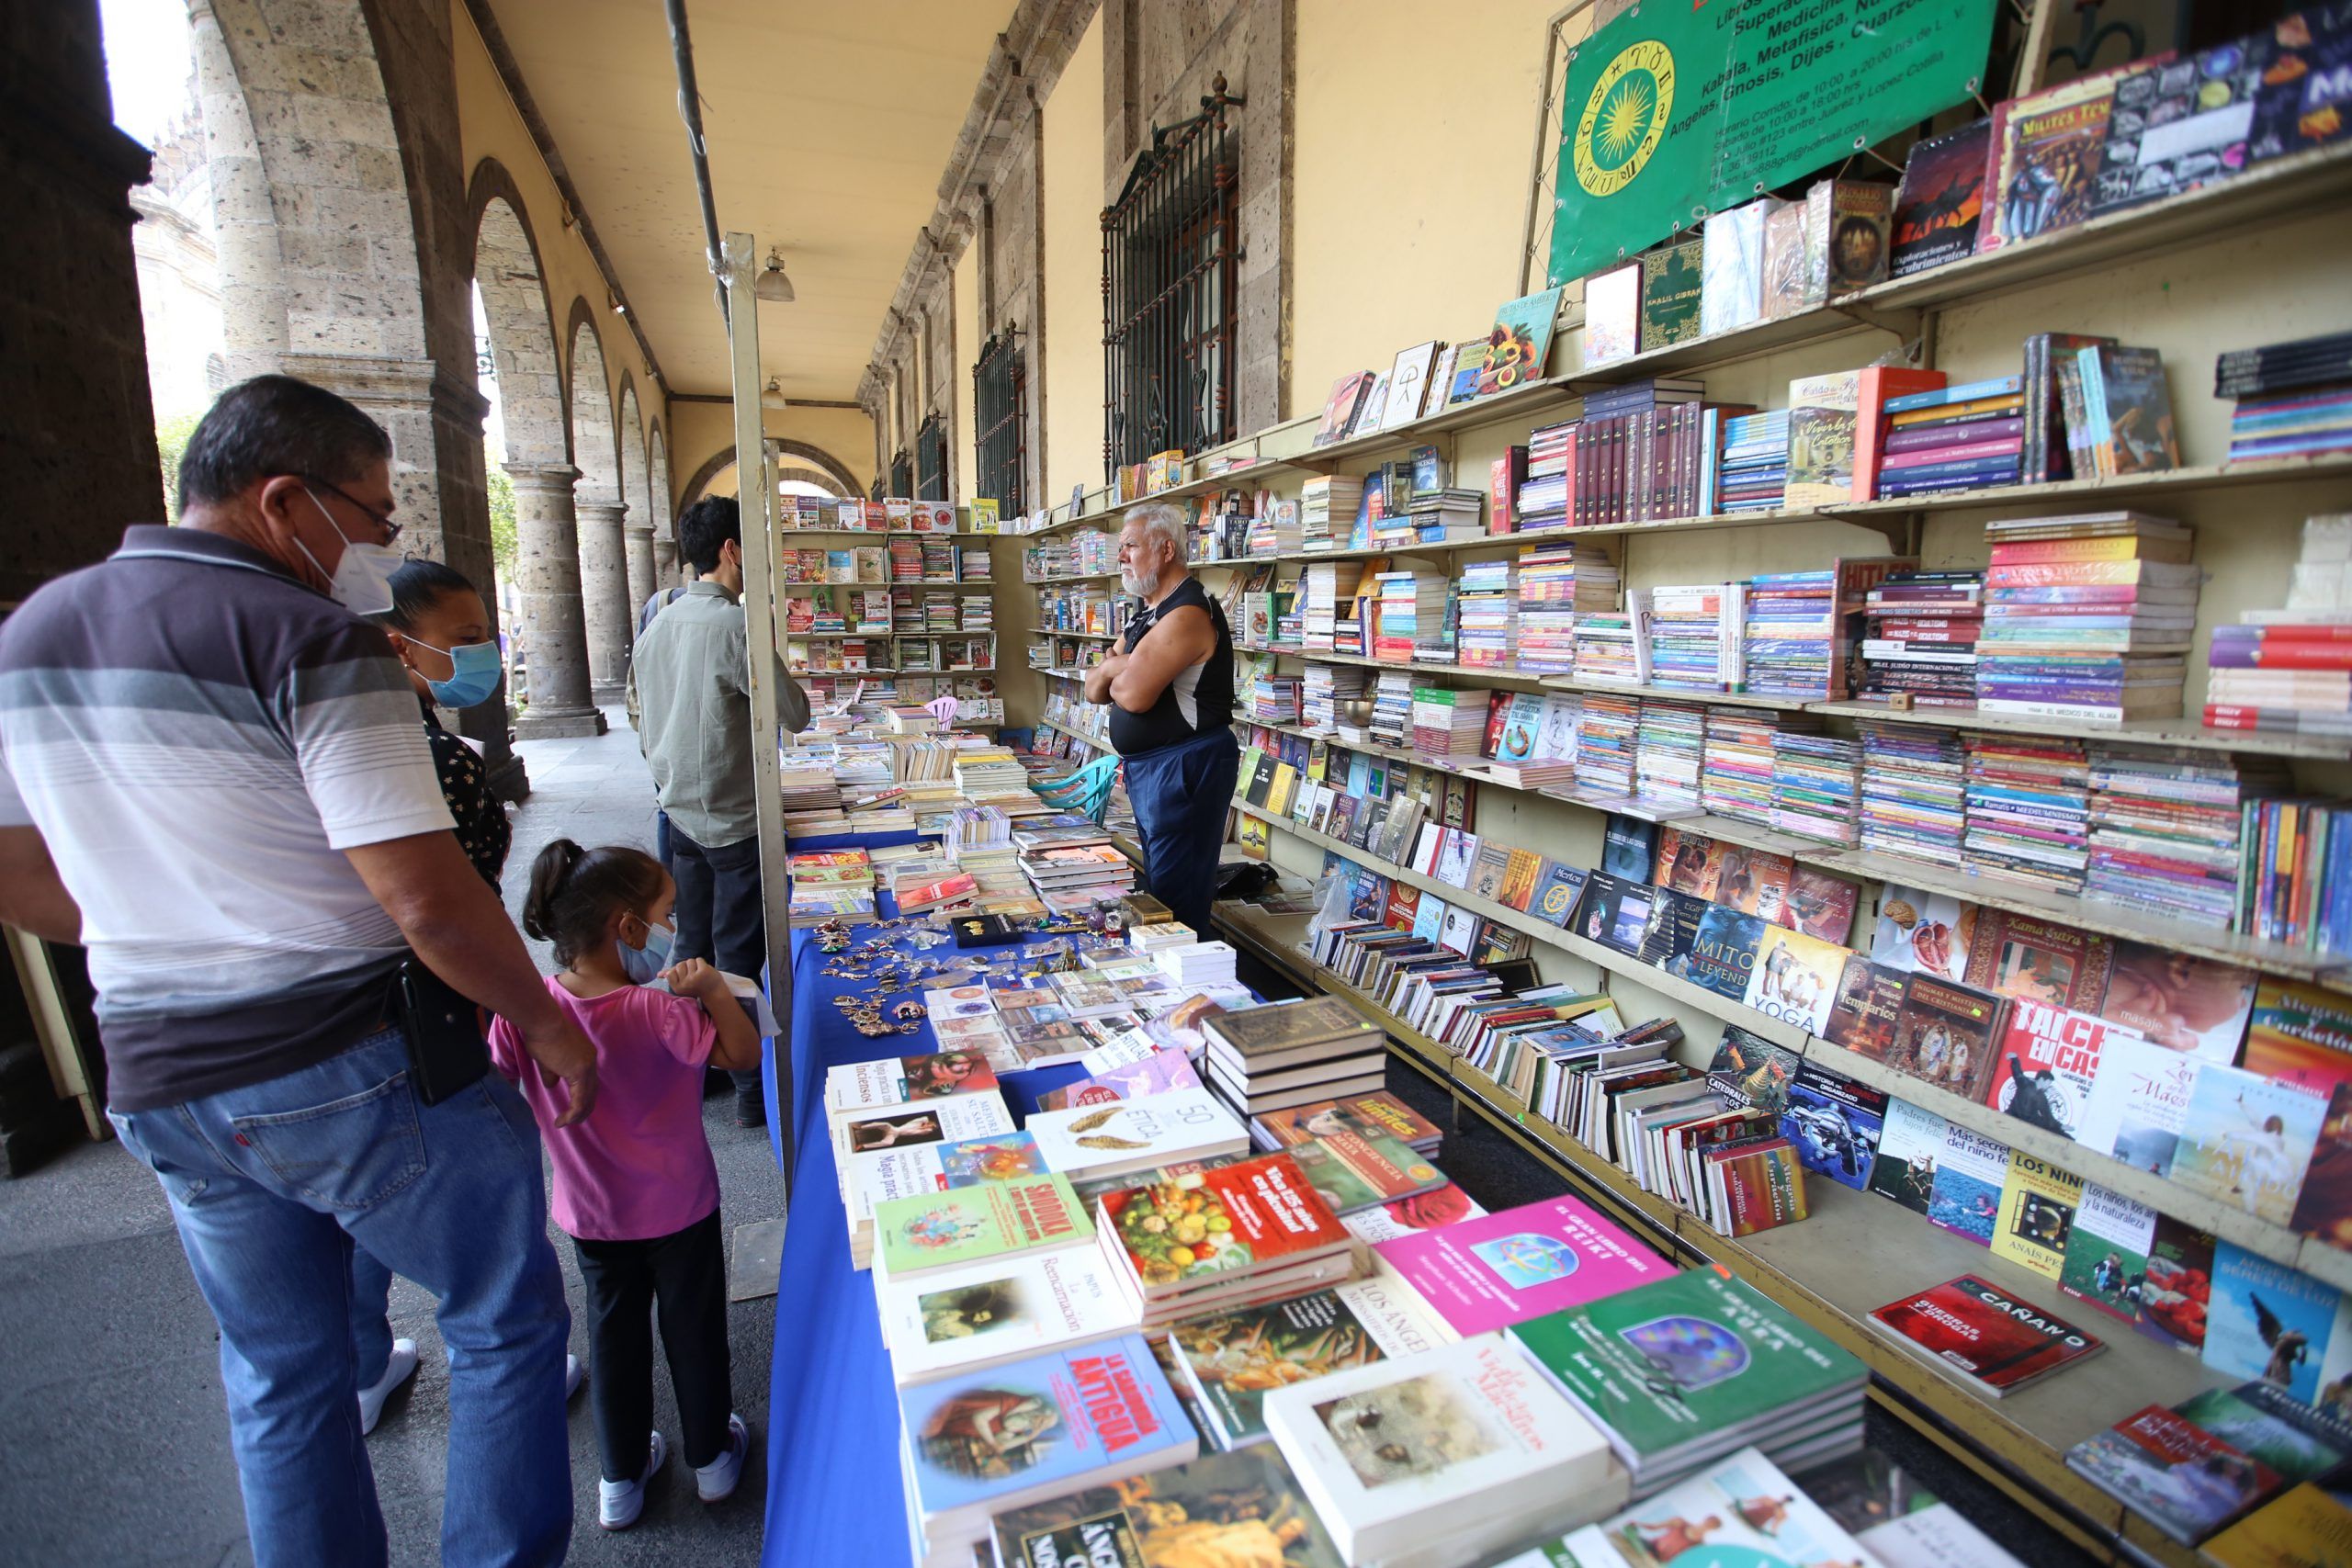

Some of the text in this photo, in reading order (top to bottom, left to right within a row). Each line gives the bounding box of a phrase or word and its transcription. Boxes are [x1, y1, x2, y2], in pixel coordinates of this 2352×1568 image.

[1669, 39, 1835, 140] Angeles, Gnosis, Dijes
[1702, 62, 1751, 98] Kabala,
[1715, 118, 1749, 137] Horario
[1796, 91, 1810, 104] de
[1814, 73, 1845, 94] 10:00
[1860, 47, 1893, 73] 20:00
[1894, 36, 1914, 54] hrs
[1751, 125, 1765, 136] de
[1769, 108, 1797, 128] 10:00
[1843, 79, 1861, 94] hrs
[1758, 130, 1786, 145] #123
[1787, 116, 1815, 134] entre
[1646, 288, 1702, 308] KHALIL GIBRAN
[1750, 857, 1790, 874] PERFECTA
[2007, 915, 2083, 947] Kama Sutra
[1695, 939, 1756, 970] MITO
[1700, 961, 1747, 987] LEYEND
[1839, 989, 1897, 1021] Templarios
[1915, 983, 1945, 998] ENIGMAS
[1951, 994, 1989, 1013] MISTERIOS
[1917, 991, 1928, 1002] DEL
[1754, 995, 1816, 1033] YOGA
[2017, 999, 2106, 1054] TAI CH
[2120, 1009, 2165, 1032] masaje
[2029, 1035, 2057, 1066] EN
[855, 1064, 872, 1103] Inciensos
[1709, 1077, 1751, 1106] CATEDRALES
[1809, 1073, 1835, 1088] HISTORIA
[1842, 1082, 1881, 1103] CRIMEN
[1819, 1083, 1859, 1102] ORGANIZADO
[2131, 1072, 2191, 1109] Maes
[967, 1098, 978, 1110] SU
[978, 1100, 1001, 1133] MEJORE
[1175, 1103, 1215, 1125] 50
[1896, 1104, 1944, 1131] Padres fue
[1903, 1118, 1922, 1134] hijos
[1949, 1125, 2011, 1156] Más secret
[1333, 1134, 1360, 1156] MAYA
[1342, 1131, 1404, 1181] CONCIENCIA
[1947, 1136, 2009, 1168] del niño fe
[879, 1155, 894, 1178] Magia
[2015, 1155, 2044, 1175] LOS
[1251, 1174, 1306, 1234] en plenitud
[1264, 1166, 1287, 1190] Viva
[1293, 1206, 1320, 1233] años
[2087, 1182, 2157, 1221] Los niños, los an
[2092, 1198, 2100, 1211] la
[2100, 1202, 2146, 1230] naturaleza
[1554, 1204, 1649, 1274] EL GRAN LIBRO DEL
[1562, 1224, 1614, 1261] REIKI
[1042, 1256, 1083, 1332] Reencarnación
[1360, 1283, 1387, 1310] LOS
[1720, 1305, 1785, 1352] AURA
[1723, 1290, 1762, 1319] GRAN
[1759, 1317, 1805, 1348] LIBRO
[1803, 1346, 1834, 1370] DEL
[1918, 1298, 1981, 1336] GUERRAS
[1924, 1309, 1980, 1341] DROGAS
[1104, 1353, 1126, 1369] LA
[1069, 1356, 1140, 1454] ANTIGUA
